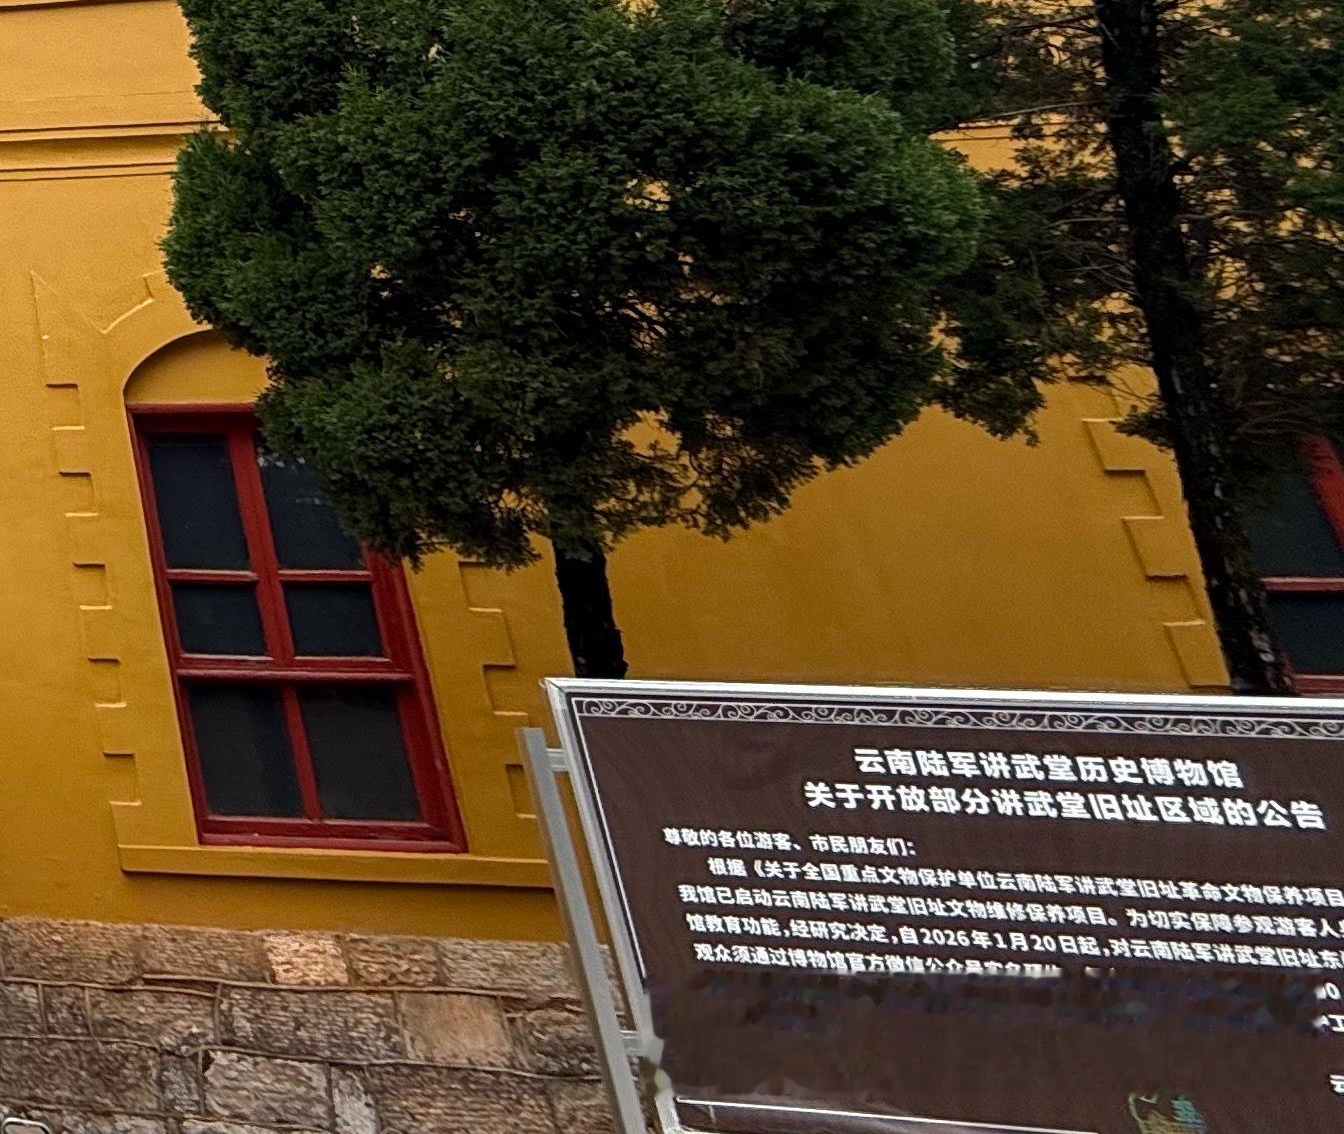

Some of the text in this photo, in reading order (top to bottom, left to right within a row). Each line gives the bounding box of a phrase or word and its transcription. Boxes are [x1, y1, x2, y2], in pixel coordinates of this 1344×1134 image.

[854, 748, 1245, 789] 云南陆军讲武堂历史博物馆
[804, 781, 1328, 830] 关于开放部分讲武堂旧址区域的公告
